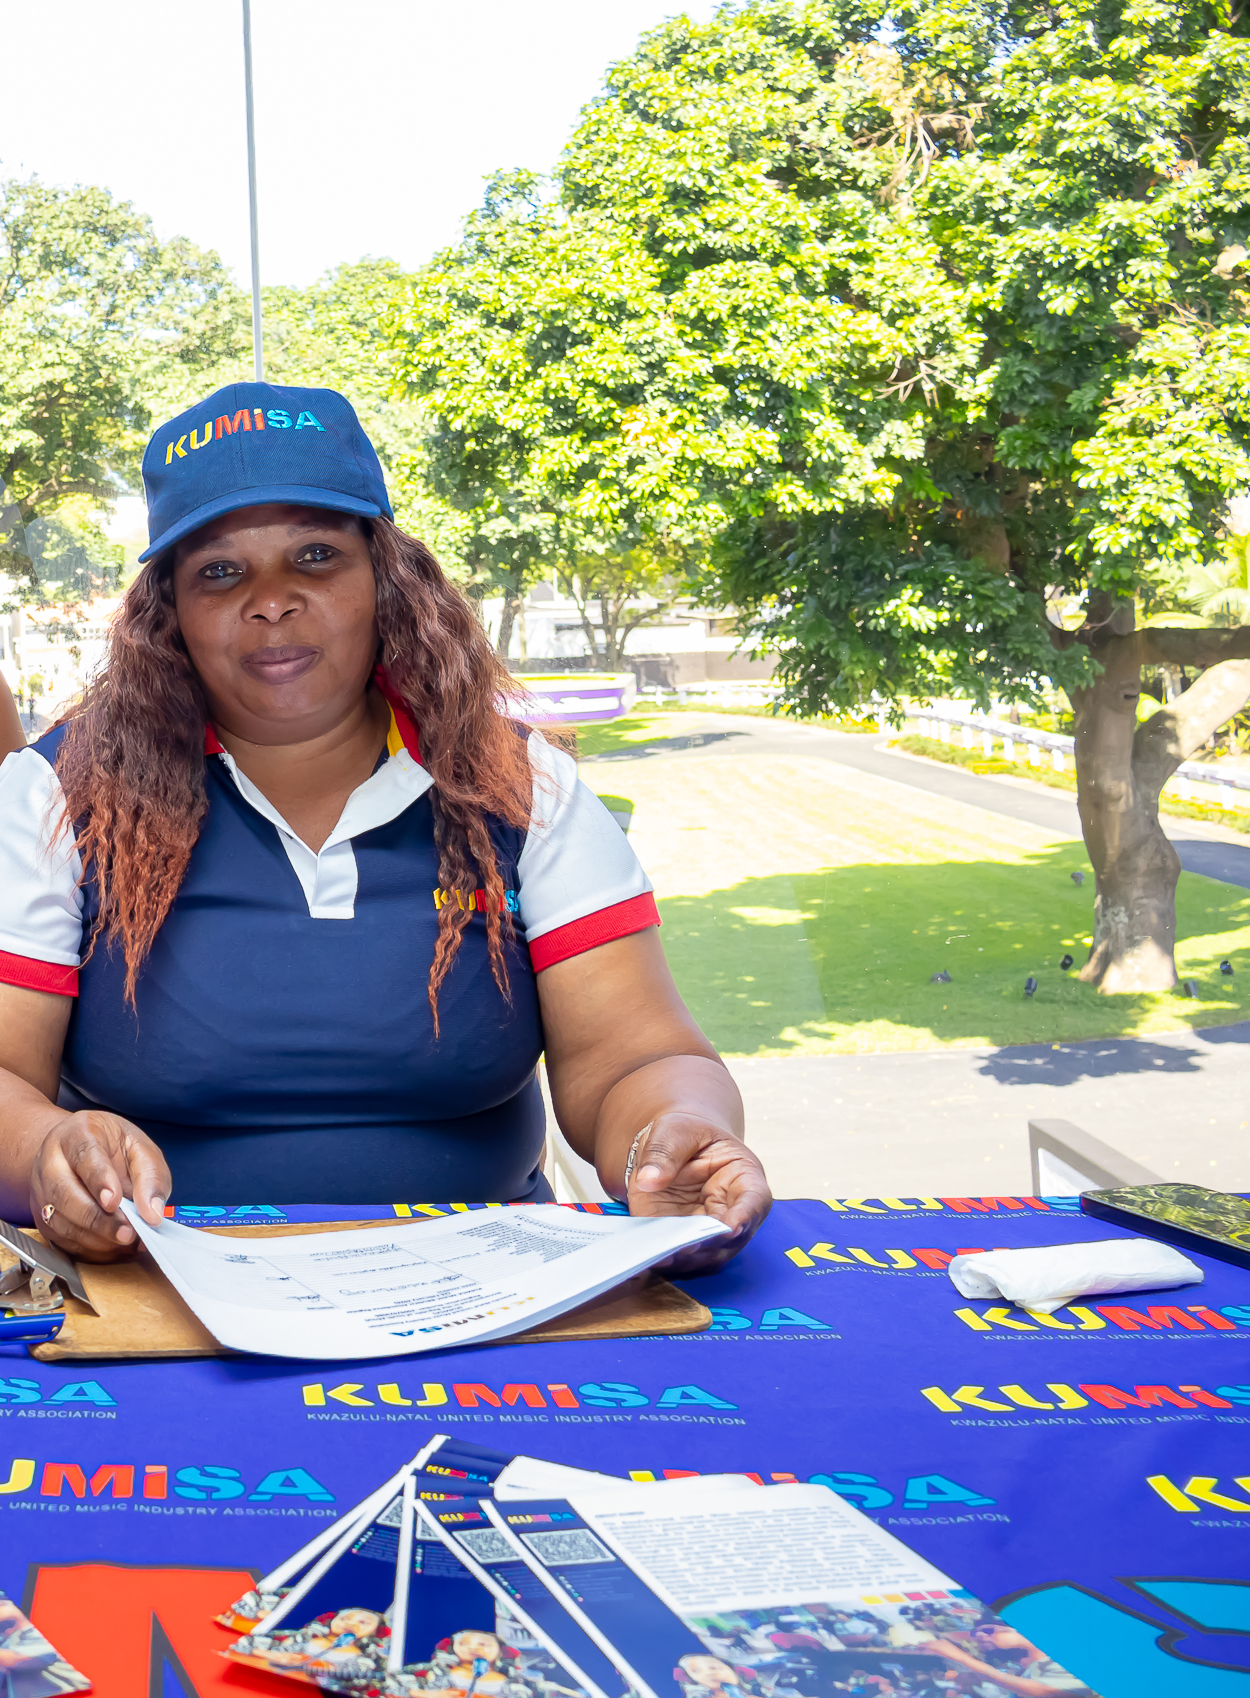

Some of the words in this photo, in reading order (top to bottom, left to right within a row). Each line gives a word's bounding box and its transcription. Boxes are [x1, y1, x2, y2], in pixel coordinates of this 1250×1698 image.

[840, 1212, 942, 1221] KWAZULU-NATAL
[943, 1212, 992, 1221] UNITED
[994, 1211, 1035, 1220] MUSIC
[783, 1241, 996, 1270] KUM
[804, 1264, 913, 1279] KWAZULU-NATAL
[916, 1269, 951, 1279] UNIT
[745, 1333, 843, 1341] ASSOCIATION
[983, 1332, 1106, 1341] KWAZULU-NATAL
[1108, 1333, 1164, 1341] UNITED
[1168, 1333, 1216, 1341] MUSIC
[919, 1382, 1250, 1413] KUMiS
[17, 1408, 117, 1420] ASSOCIATION
[307, 1411, 433, 1424] KWAZULU-NATAL
[437, 1412, 495, 1424] UNITED
[498, 1413, 550, 1424] MUSIC
[554, 1413, 633, 1424] INDUSTRY
[638, 1413, 747, 1426] ASSOCIATION
[949, 1415, 1084, 1428] KWAZULU-NATAL
[1091, 1414, 1154, 1426] UNITED
[1155, 1412, 1211, 1425] MUSIC
[8, 1500, 71, 1513] UNITED
[75, 1502, 128, 1514] MUSIC
[133, 1503, 218, 1517] INDUSTRY
[222, 1505, 338, 1519] ASSOCIATION
[887, 1511, 1011, 1527] ASSOCIATION
